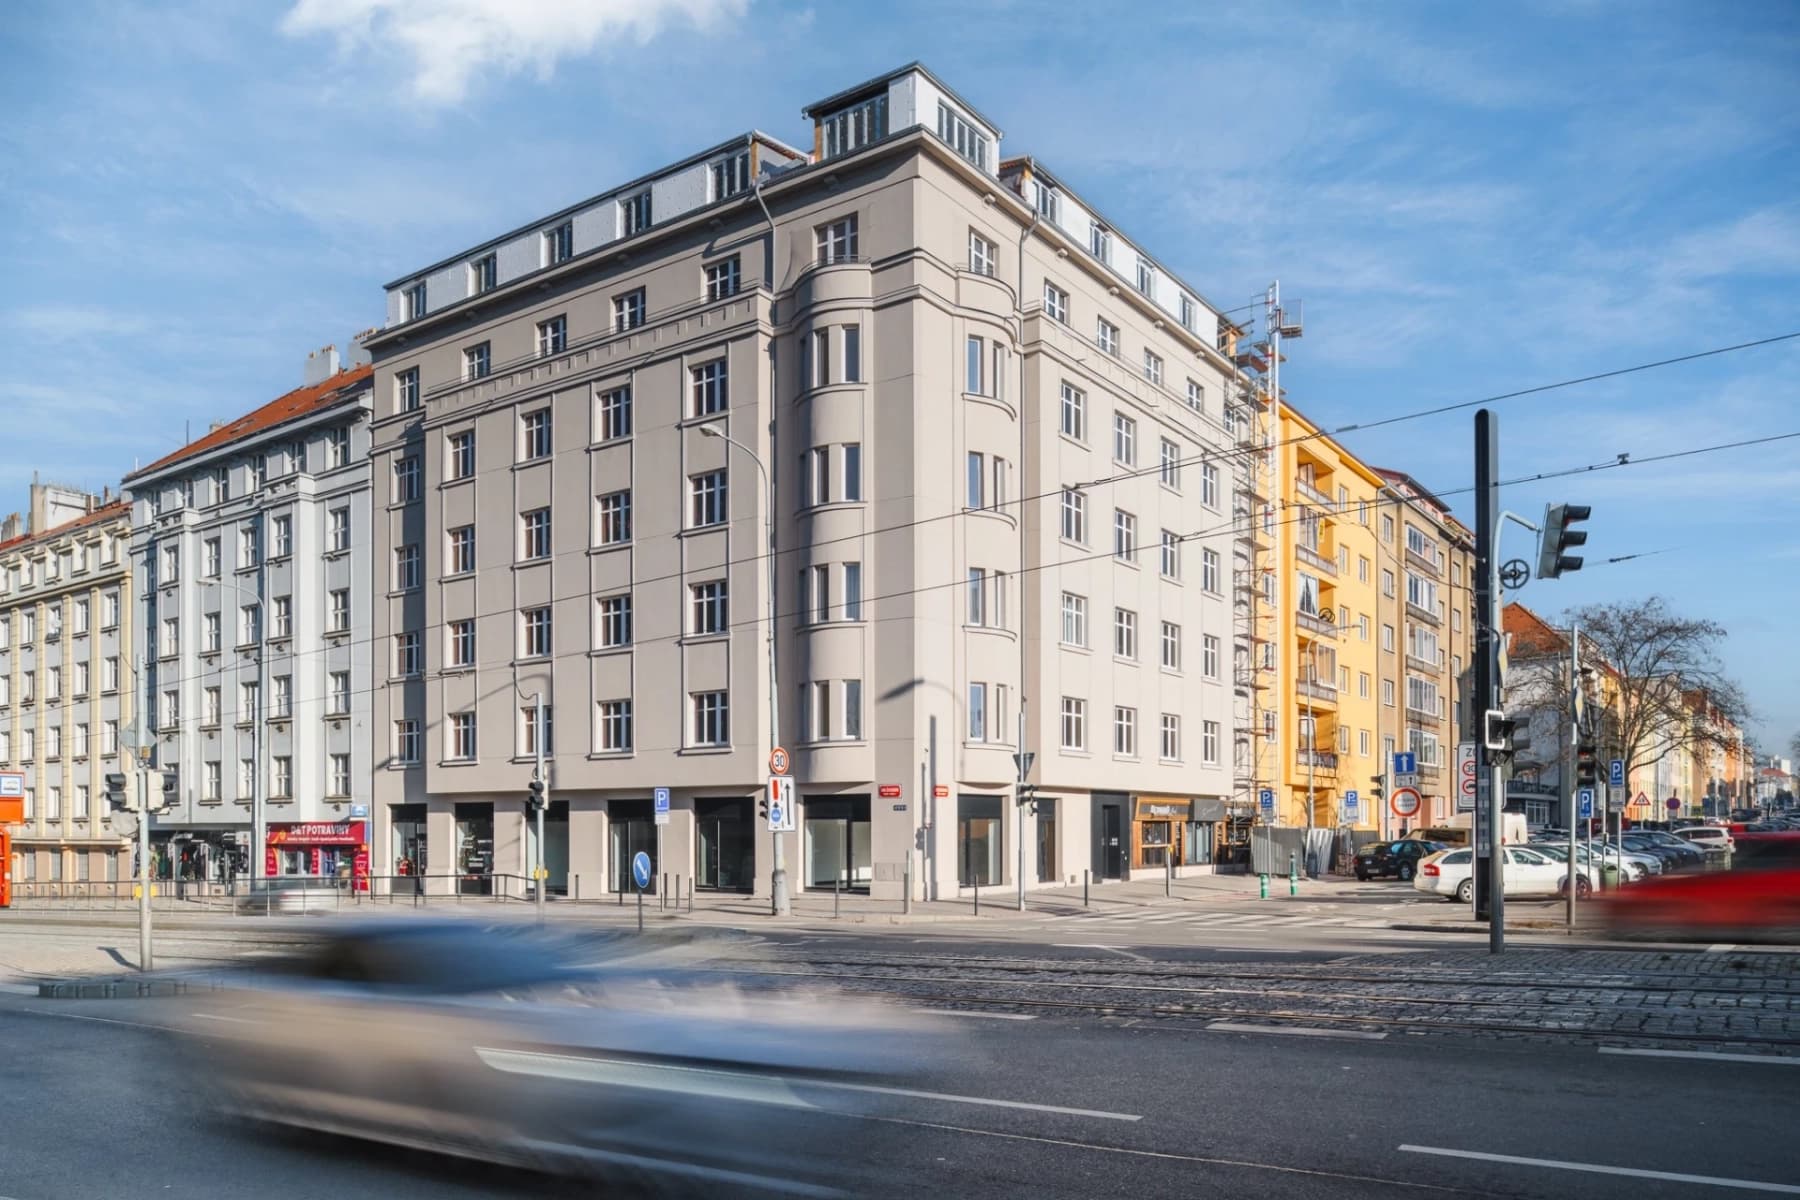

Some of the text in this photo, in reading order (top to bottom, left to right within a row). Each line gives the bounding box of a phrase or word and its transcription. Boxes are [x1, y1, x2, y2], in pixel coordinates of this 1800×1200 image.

[775, 755, 784, 767] 30
[1612, 763, 1621, 778] P
[658, 791, 666, 806] P
[1262, 792, 1271, 803] P
[1347, 792, 1355, 803] P
[1581, 793, 1589, 809] P
[306, 824, 349, 835] POTRAVINY
